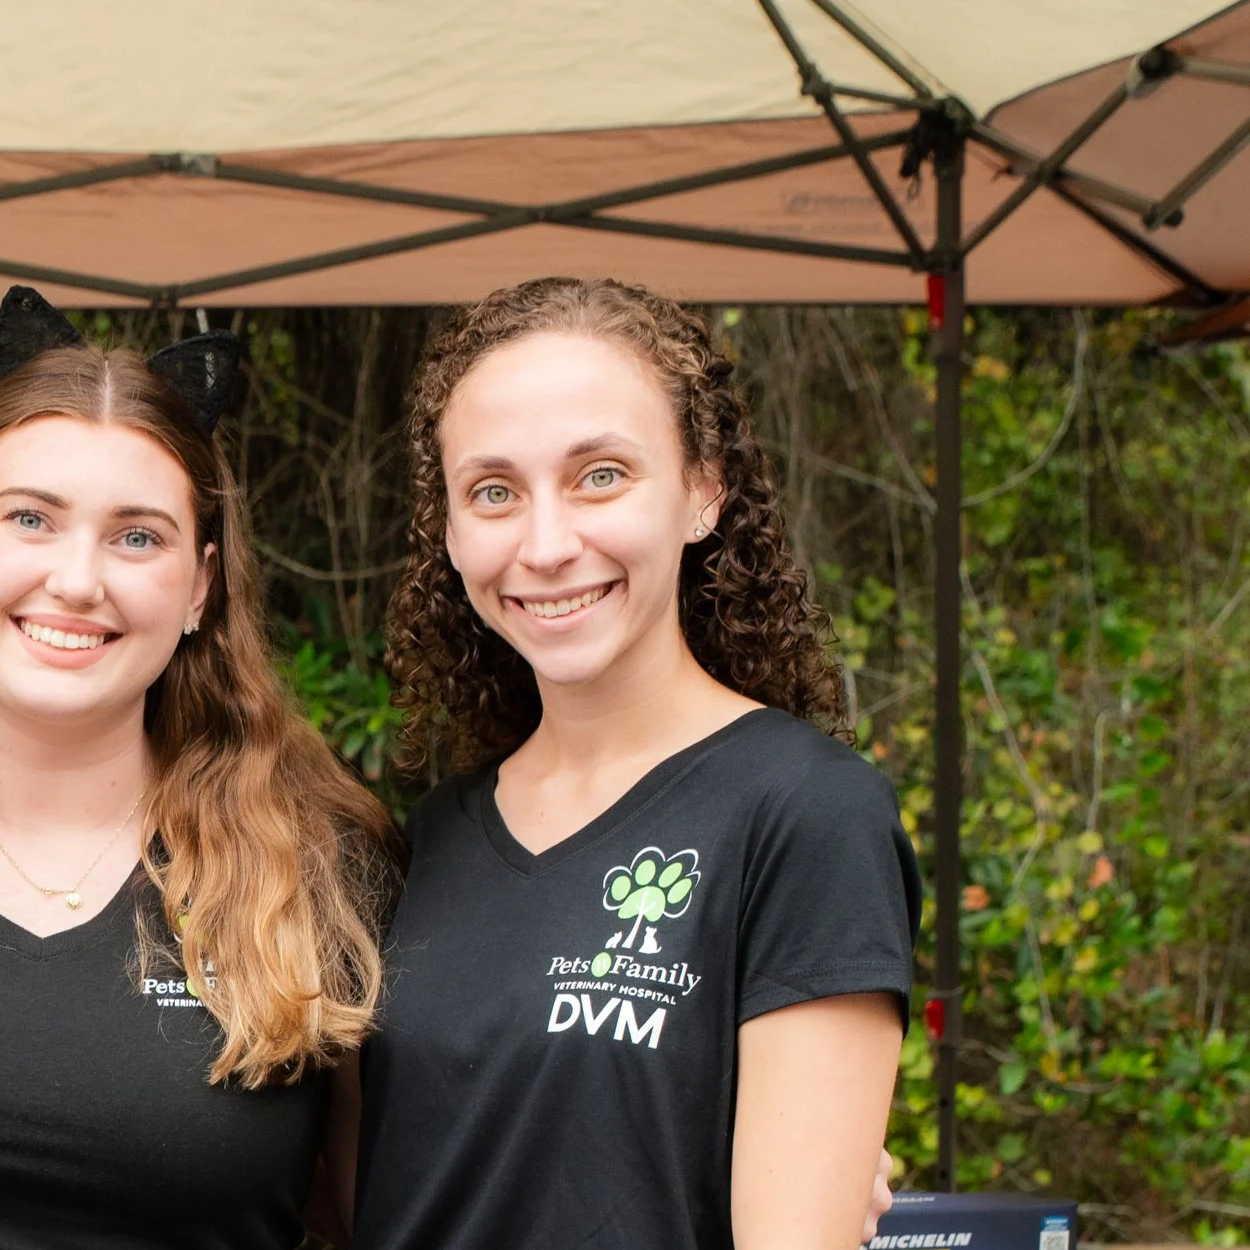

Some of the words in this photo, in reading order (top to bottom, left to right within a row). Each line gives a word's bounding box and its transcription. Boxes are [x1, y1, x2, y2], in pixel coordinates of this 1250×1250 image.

[142, 978, 185, 994] Pets
[547, 956, 592, 976] Pets
[609, 954, 702, 996] Family
[553, 981, 617, 992] VETERINARY
[619, 985, 677, 1006] HOSPITAL
[547, 994, 667, 1050] DVM
[869, 1232, 972, 1250] MICHELIN
